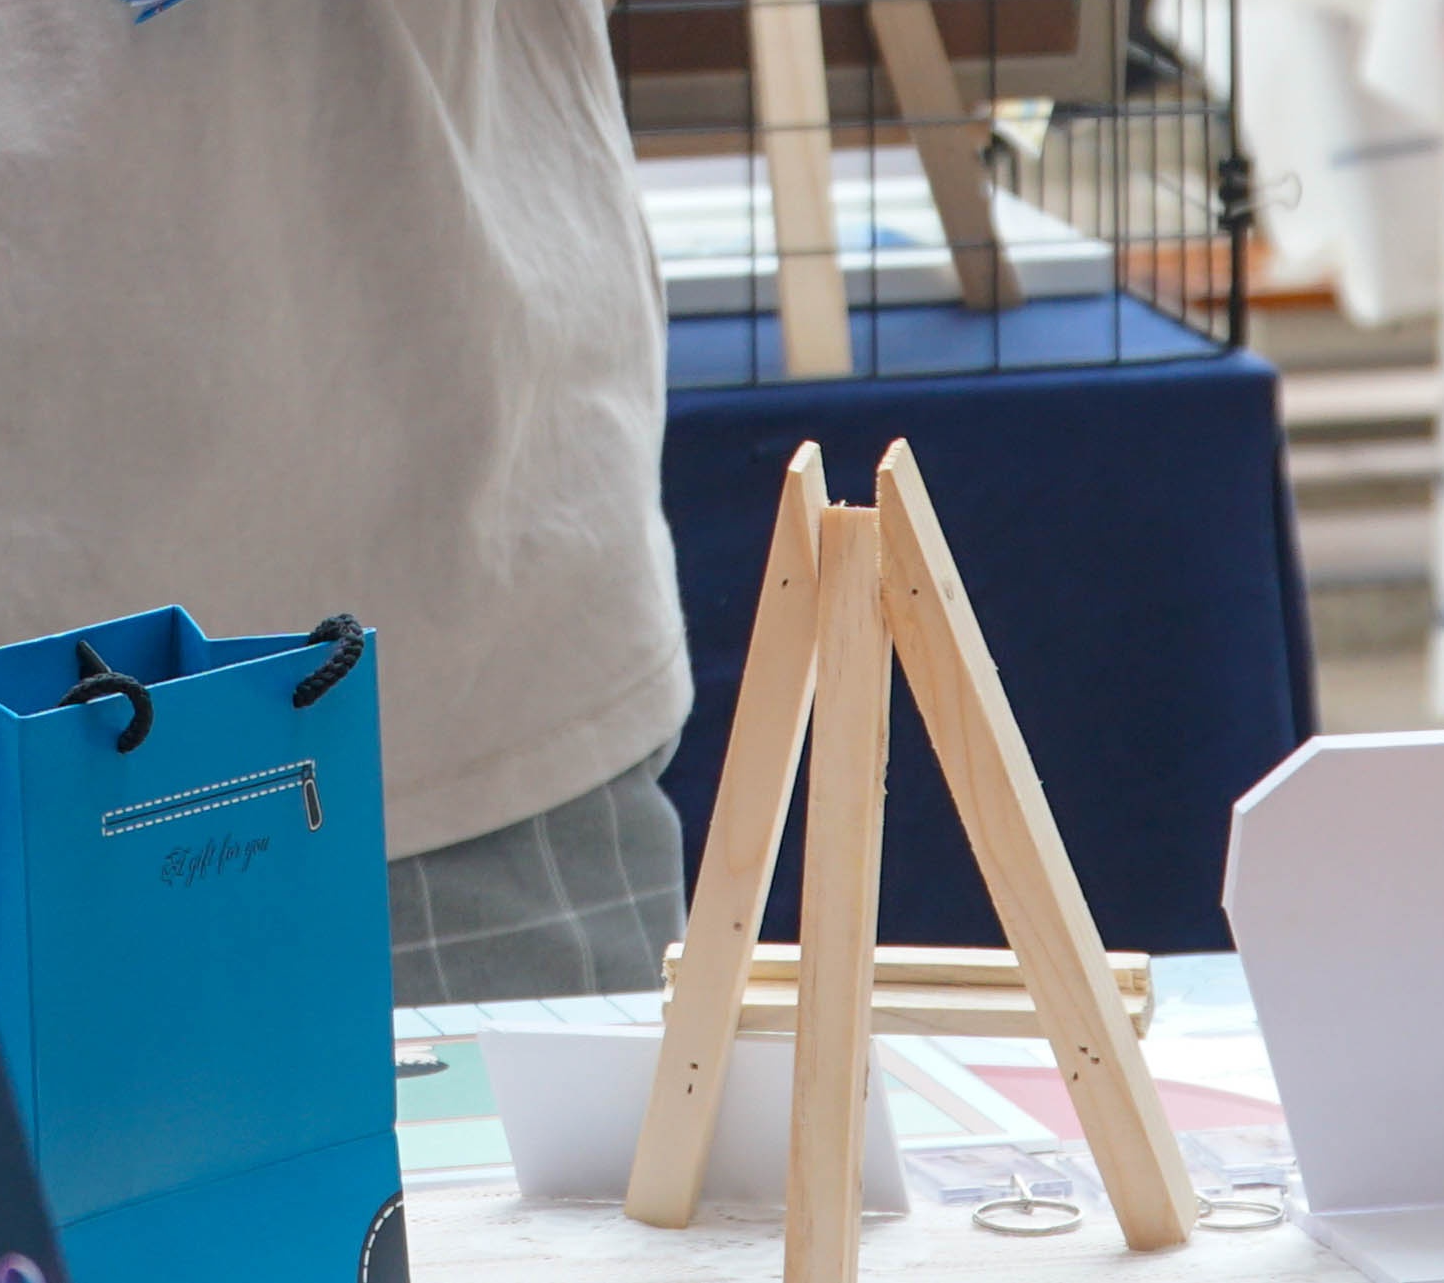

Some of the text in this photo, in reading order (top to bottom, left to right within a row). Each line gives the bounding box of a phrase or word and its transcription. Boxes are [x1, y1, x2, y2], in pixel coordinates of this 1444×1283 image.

[185, 837, 216, 887] gift
[217, 832, 240, 874] for
[242, 835, 271, 873] you
